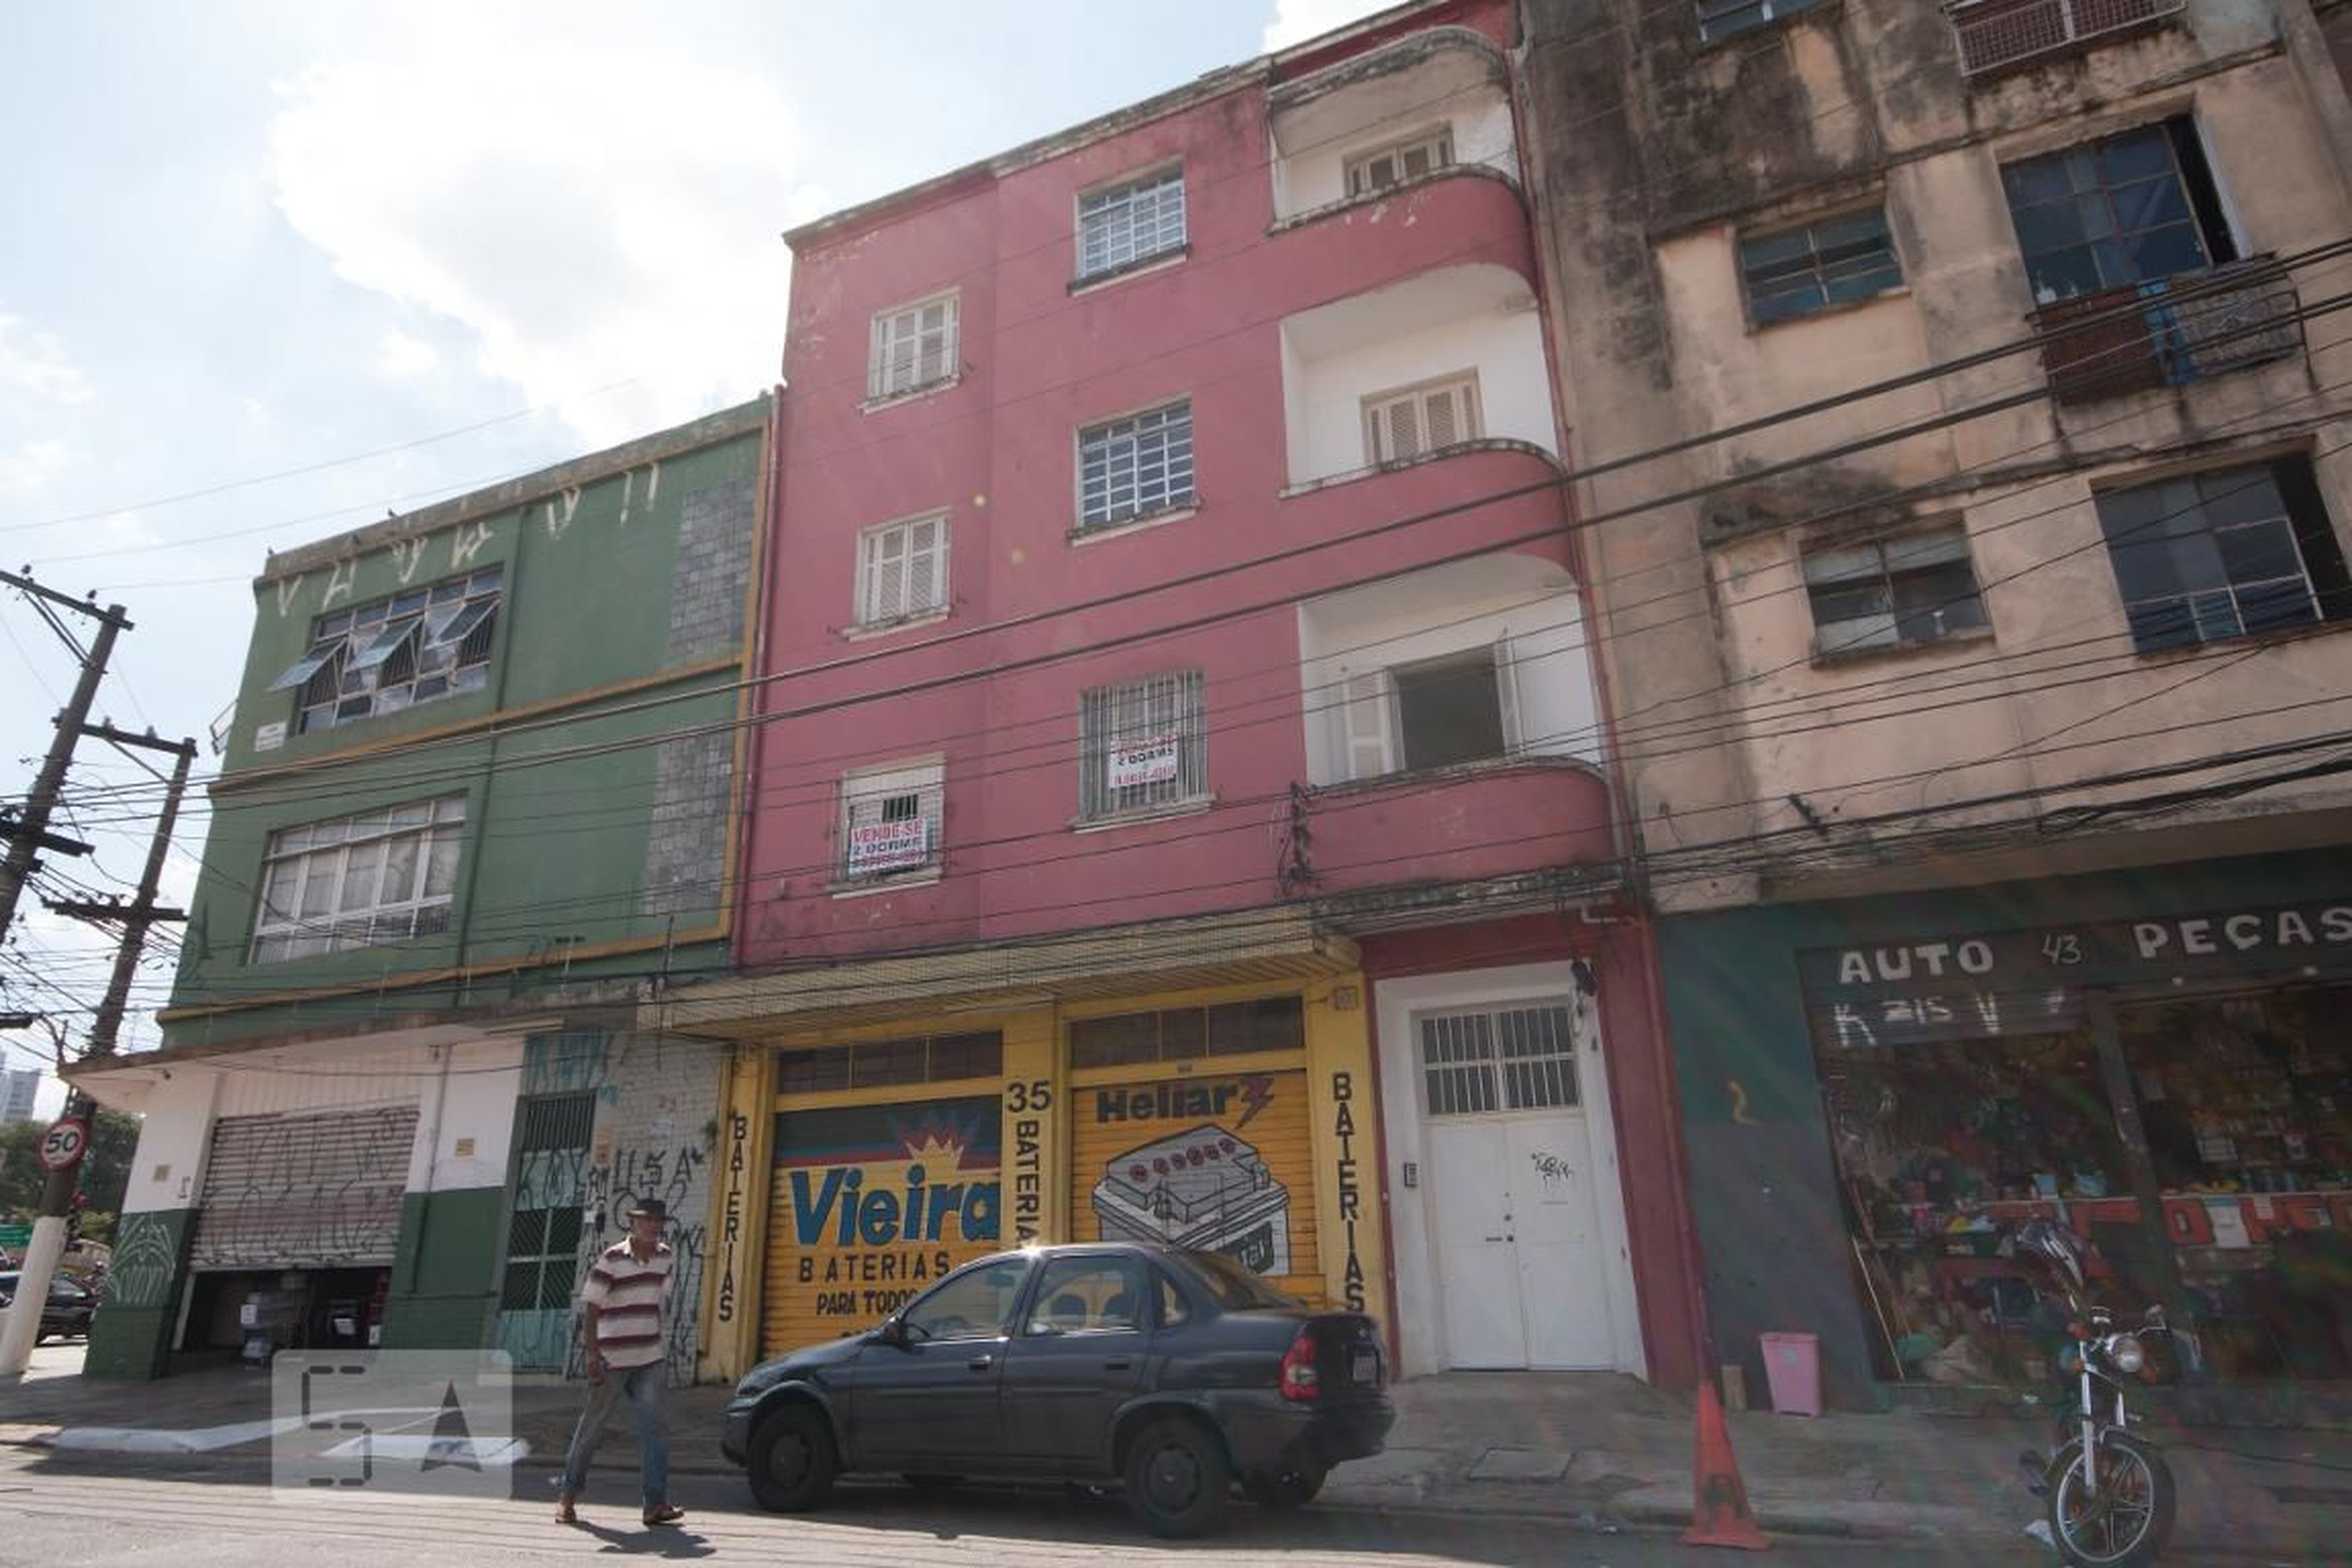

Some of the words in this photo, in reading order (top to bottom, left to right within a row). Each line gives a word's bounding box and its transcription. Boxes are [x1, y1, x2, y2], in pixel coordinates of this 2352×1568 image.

[1840, 940, 1994, 984] AUTO
[2041, 933, 2082, 965] 43
[1008, 1080, 1052, 1113] 35
[45, 1131, 80, 1154] 50
[791, 1164, 1001, 1246] Vieira
[1332, 1071, 1365, 1312] BATERIAS
[718, 1115, 748, 1322] BATERIAS
[799, 1251, 949, 1283] BATERIAS
[816, 1291, 857, 1316] PARA
